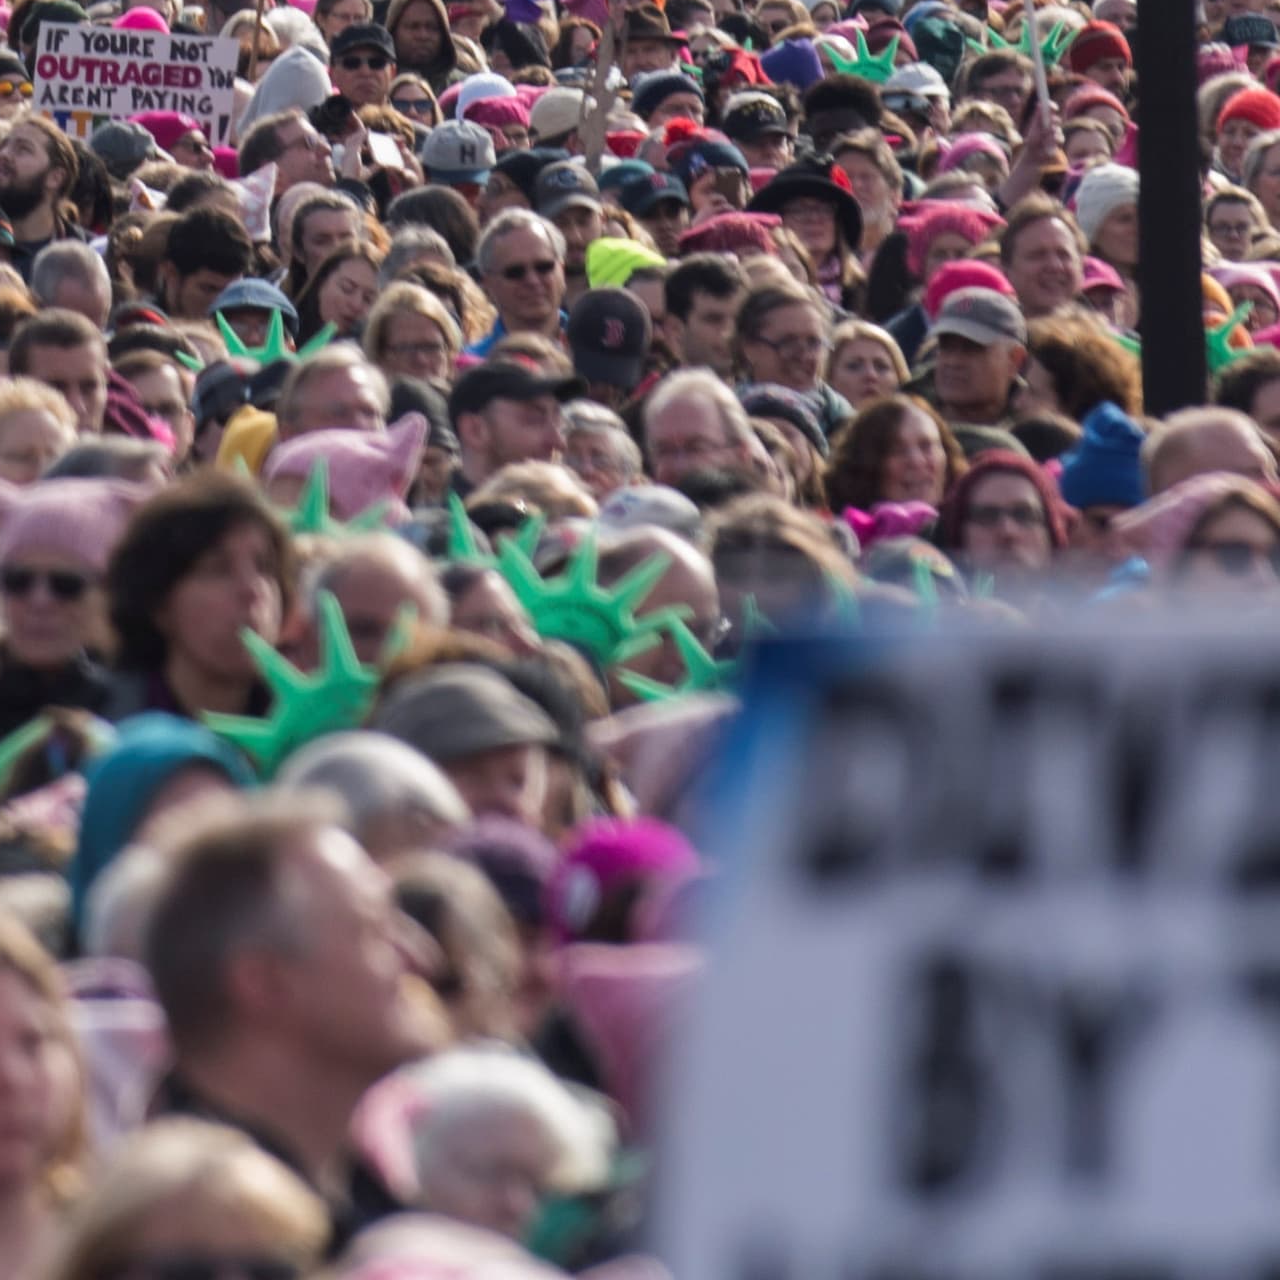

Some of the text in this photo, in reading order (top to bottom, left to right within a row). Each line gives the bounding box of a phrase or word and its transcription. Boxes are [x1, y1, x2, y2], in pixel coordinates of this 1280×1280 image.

[45, 28, 69, 53] IF
[169, 39, 214, 63] NOT
[37, 54, 203, 88] OUTRAGED
[131, 87, 214, 114] PAYING
[459, 142, 476, 164] H
